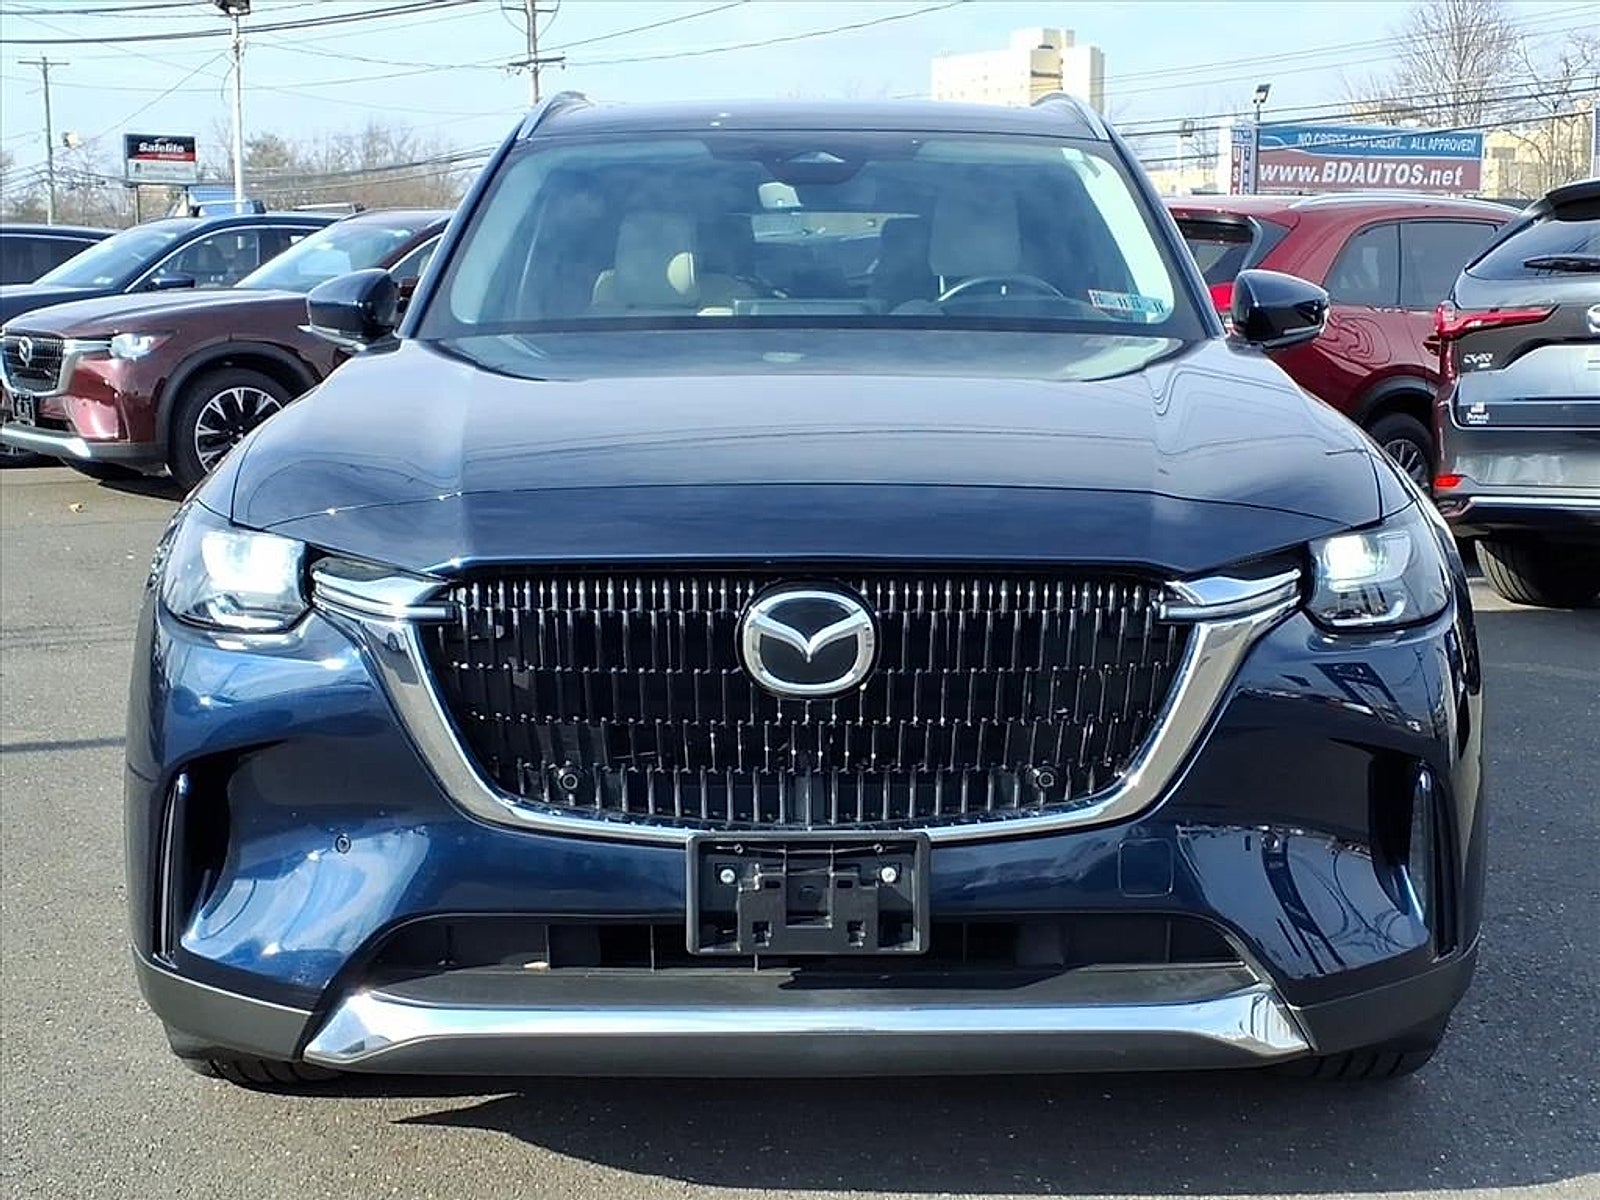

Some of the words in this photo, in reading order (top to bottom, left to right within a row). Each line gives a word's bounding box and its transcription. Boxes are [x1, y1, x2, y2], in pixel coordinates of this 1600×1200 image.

[138, 142, 184, 153] Safelite
[1411, 137, 1426, 150] ALL
[1428, 137, 1477, 152] APPROVED!
[1259, 161, 1463, 186] www.BDAUTOS.net
